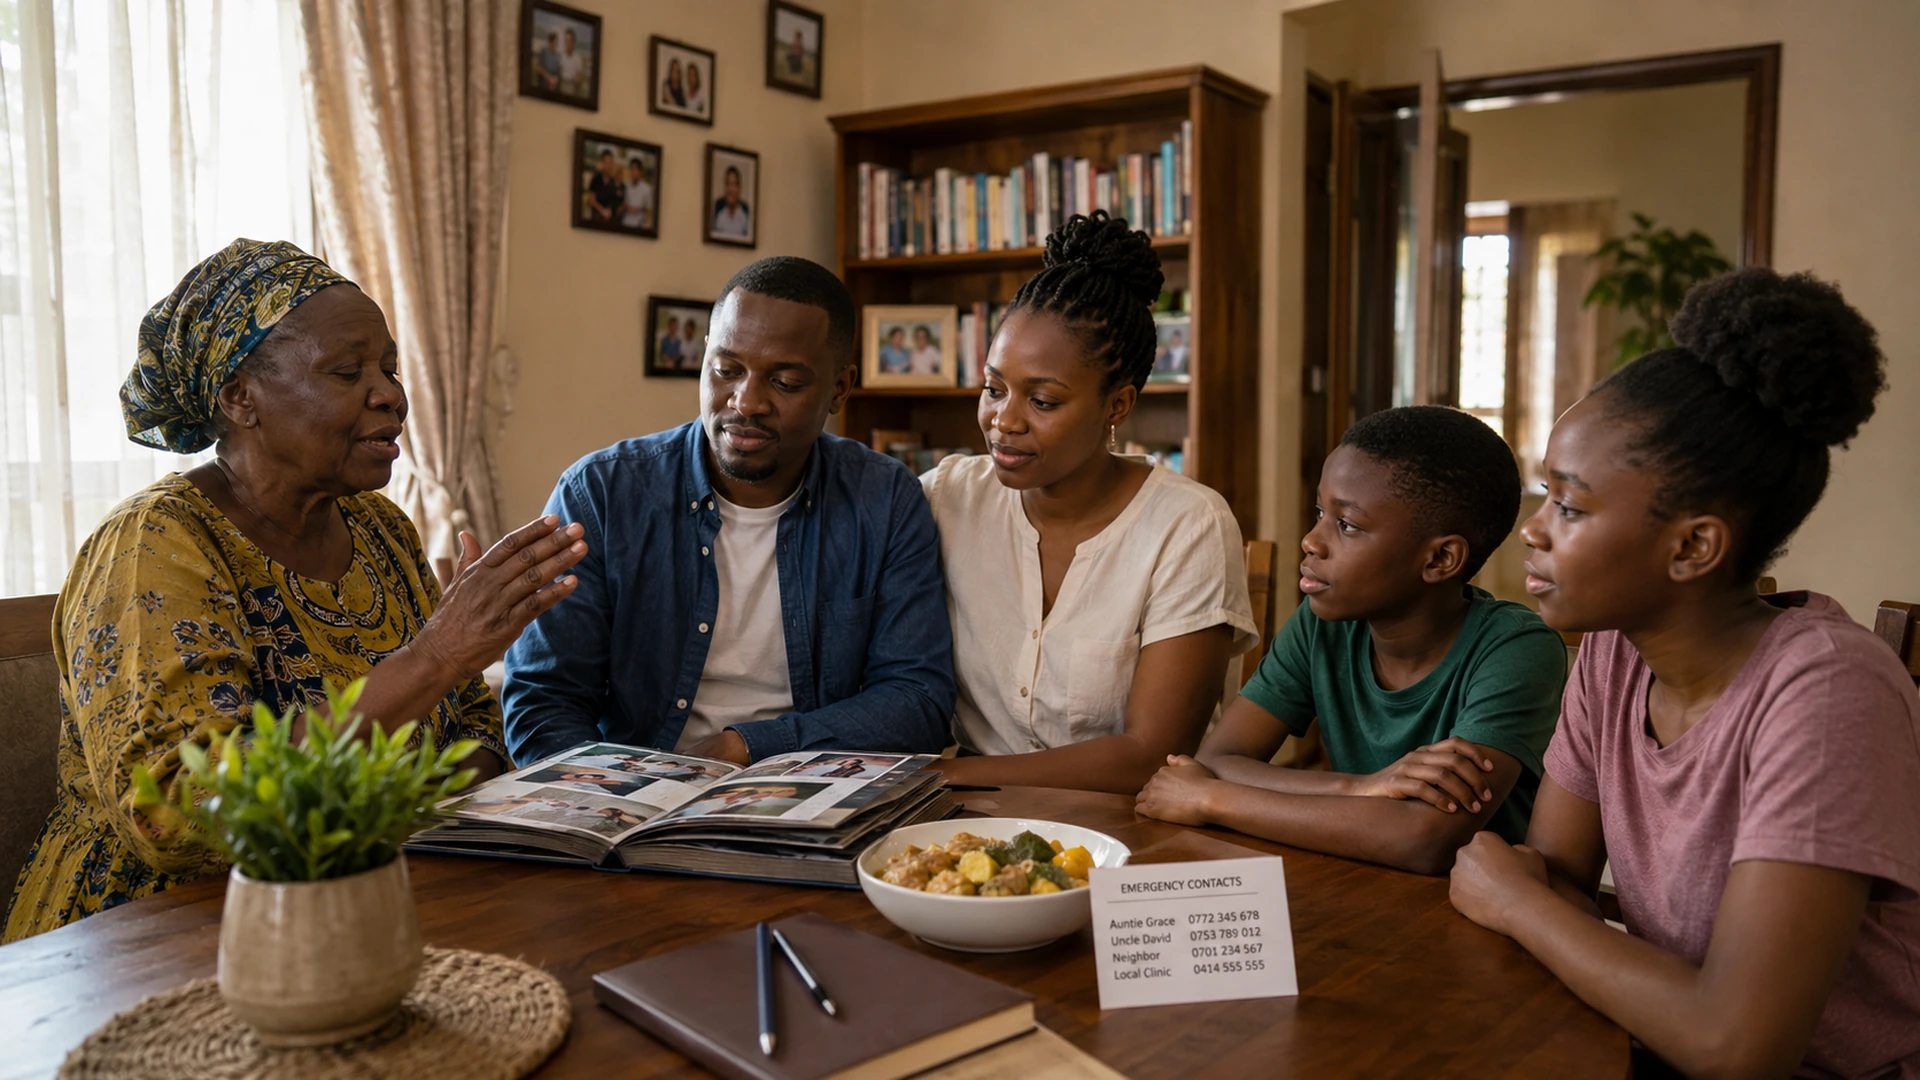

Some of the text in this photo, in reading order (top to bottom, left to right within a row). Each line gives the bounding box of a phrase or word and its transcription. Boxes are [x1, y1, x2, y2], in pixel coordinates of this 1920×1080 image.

[1121, 876, 1242, 894] EMERGENCY CONTACTS
[1110, 910, 1259, 929] Auntie Grace 0772 345 678
[1111, 927, 1261, 946] Uncle David 0753 789 012
[1113, 943, 1262, 964] Neighbor 0701 234 567
[1114, 960, 1265, 980] Local Clinic 0414 555 555
